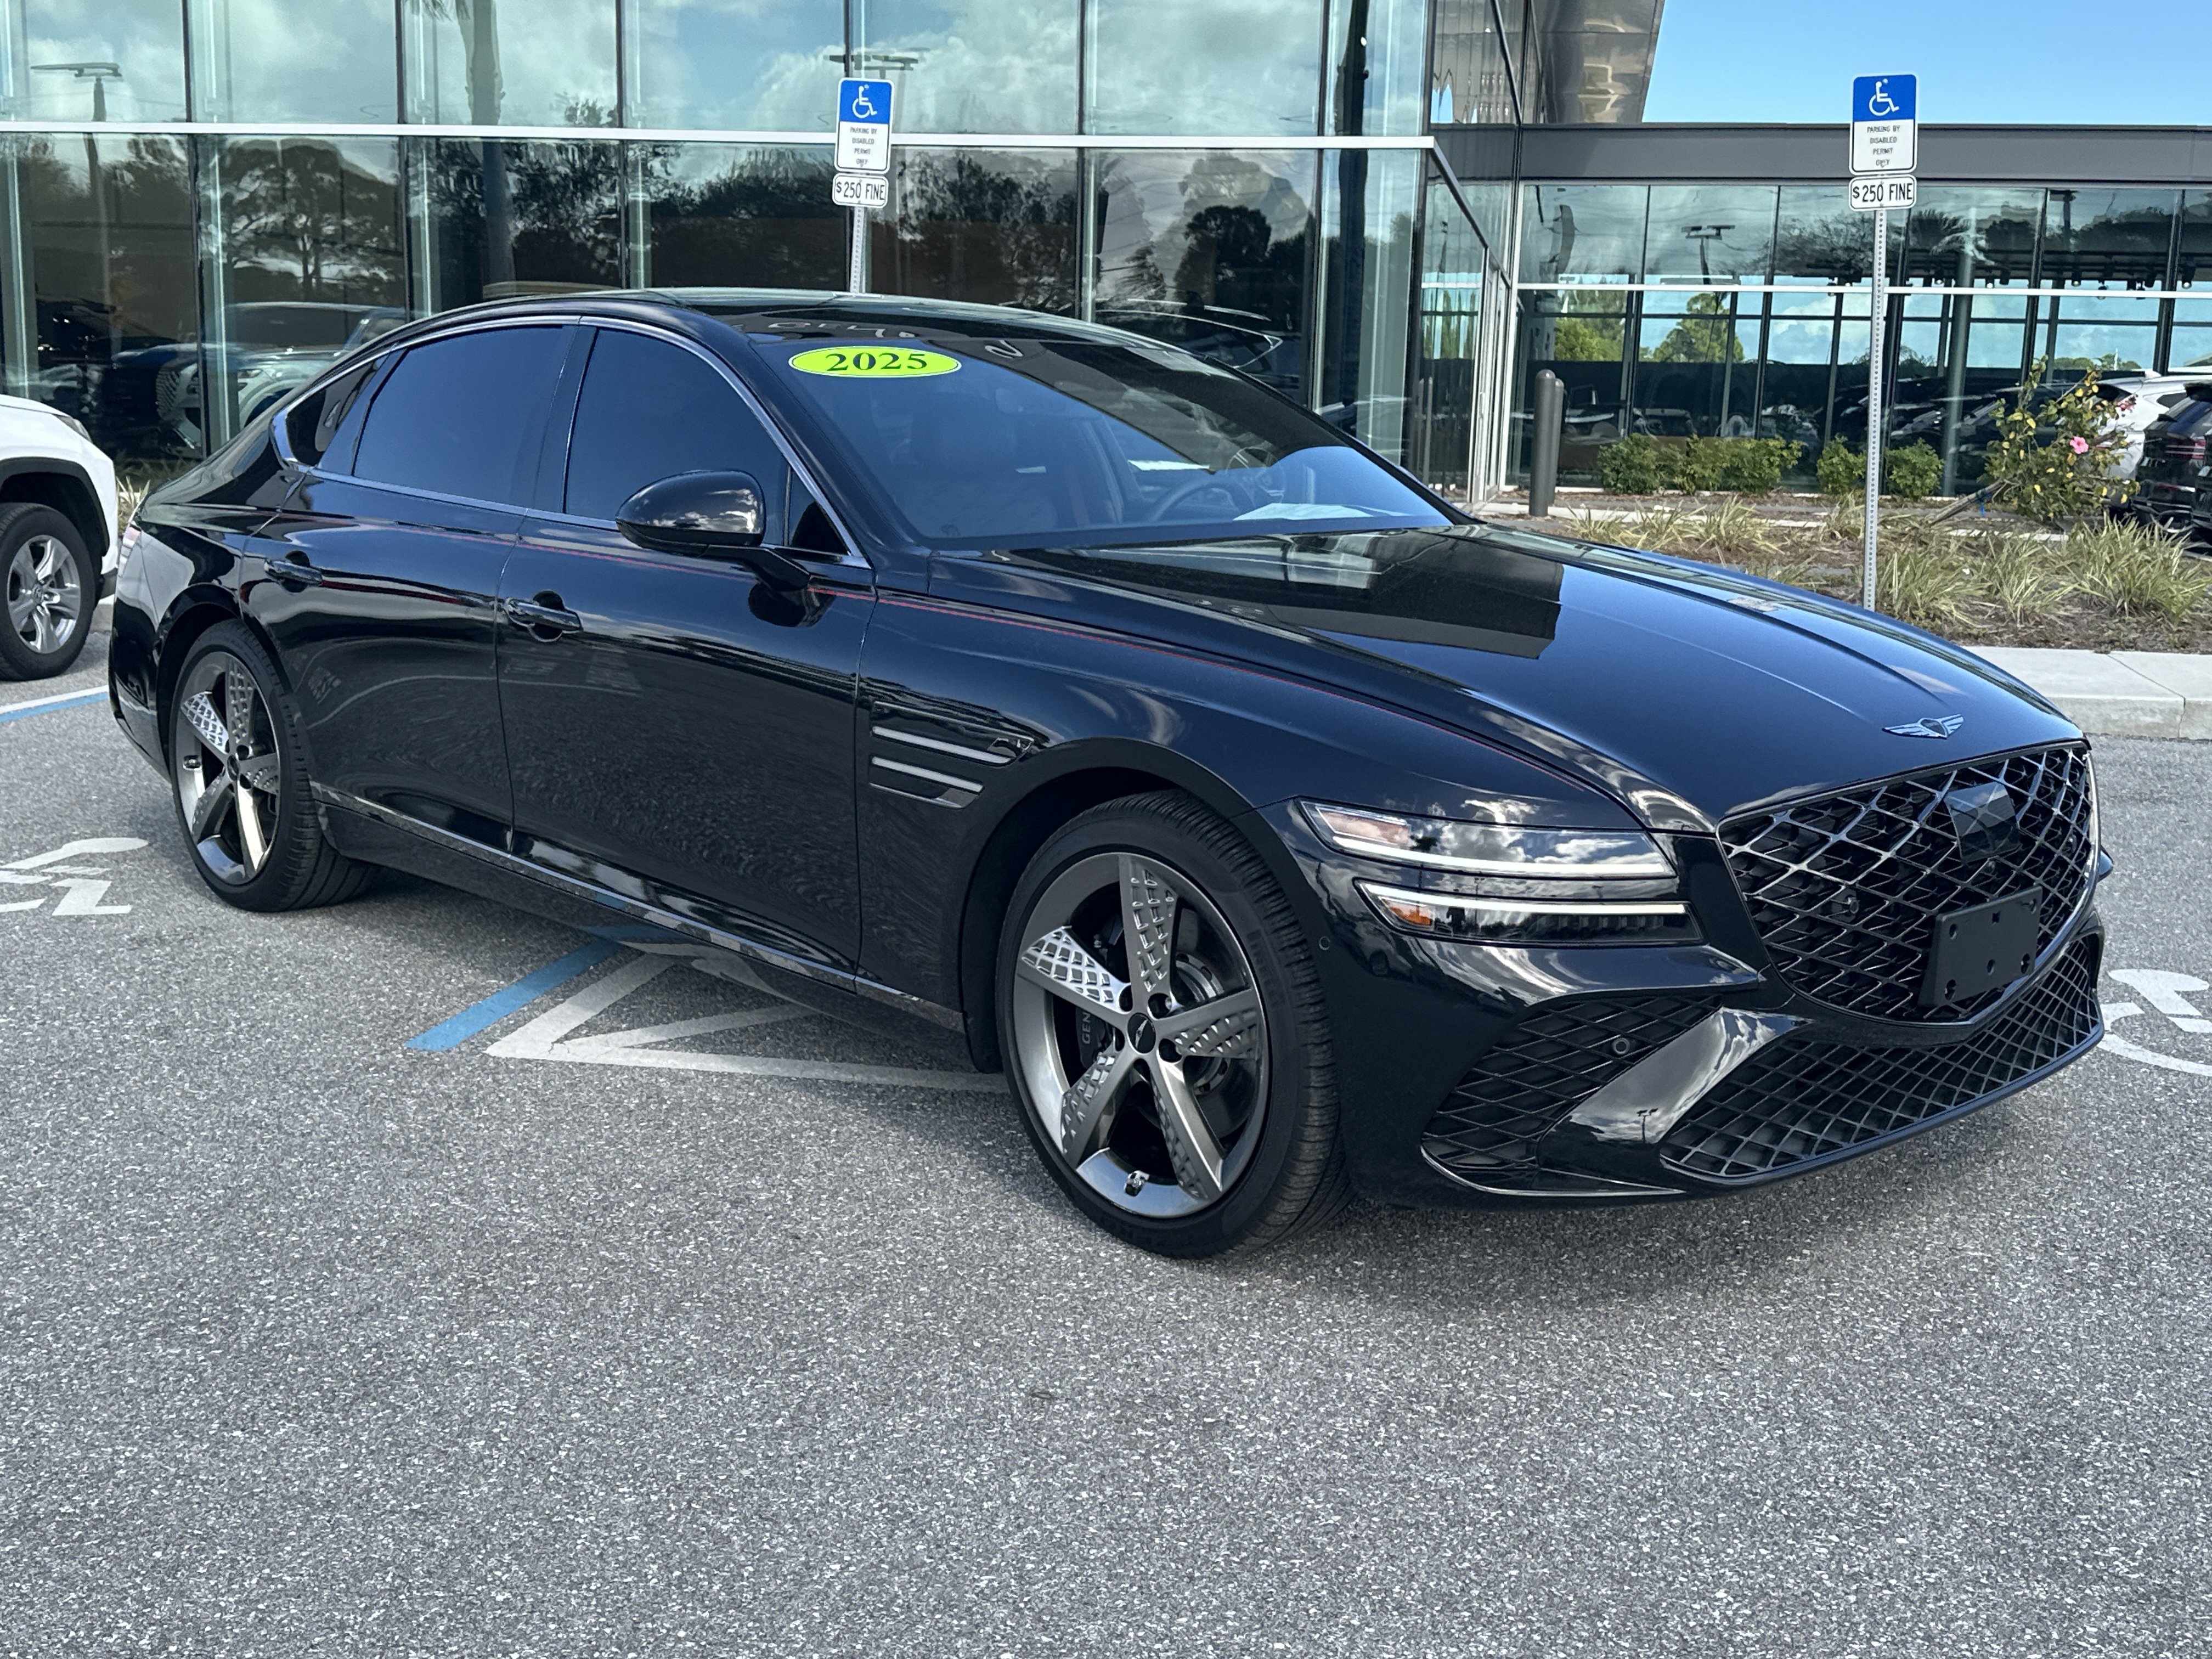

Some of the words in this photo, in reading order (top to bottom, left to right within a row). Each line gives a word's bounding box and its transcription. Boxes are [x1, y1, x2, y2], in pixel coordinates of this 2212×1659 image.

[836, 181, 861, 198] $250
[865, 183, 885, 200] FINE
[1853, 184, 1884, 202] $250
[1889, 183, 1912, 201] FINE
[825, 352, 928, 371] 2025
